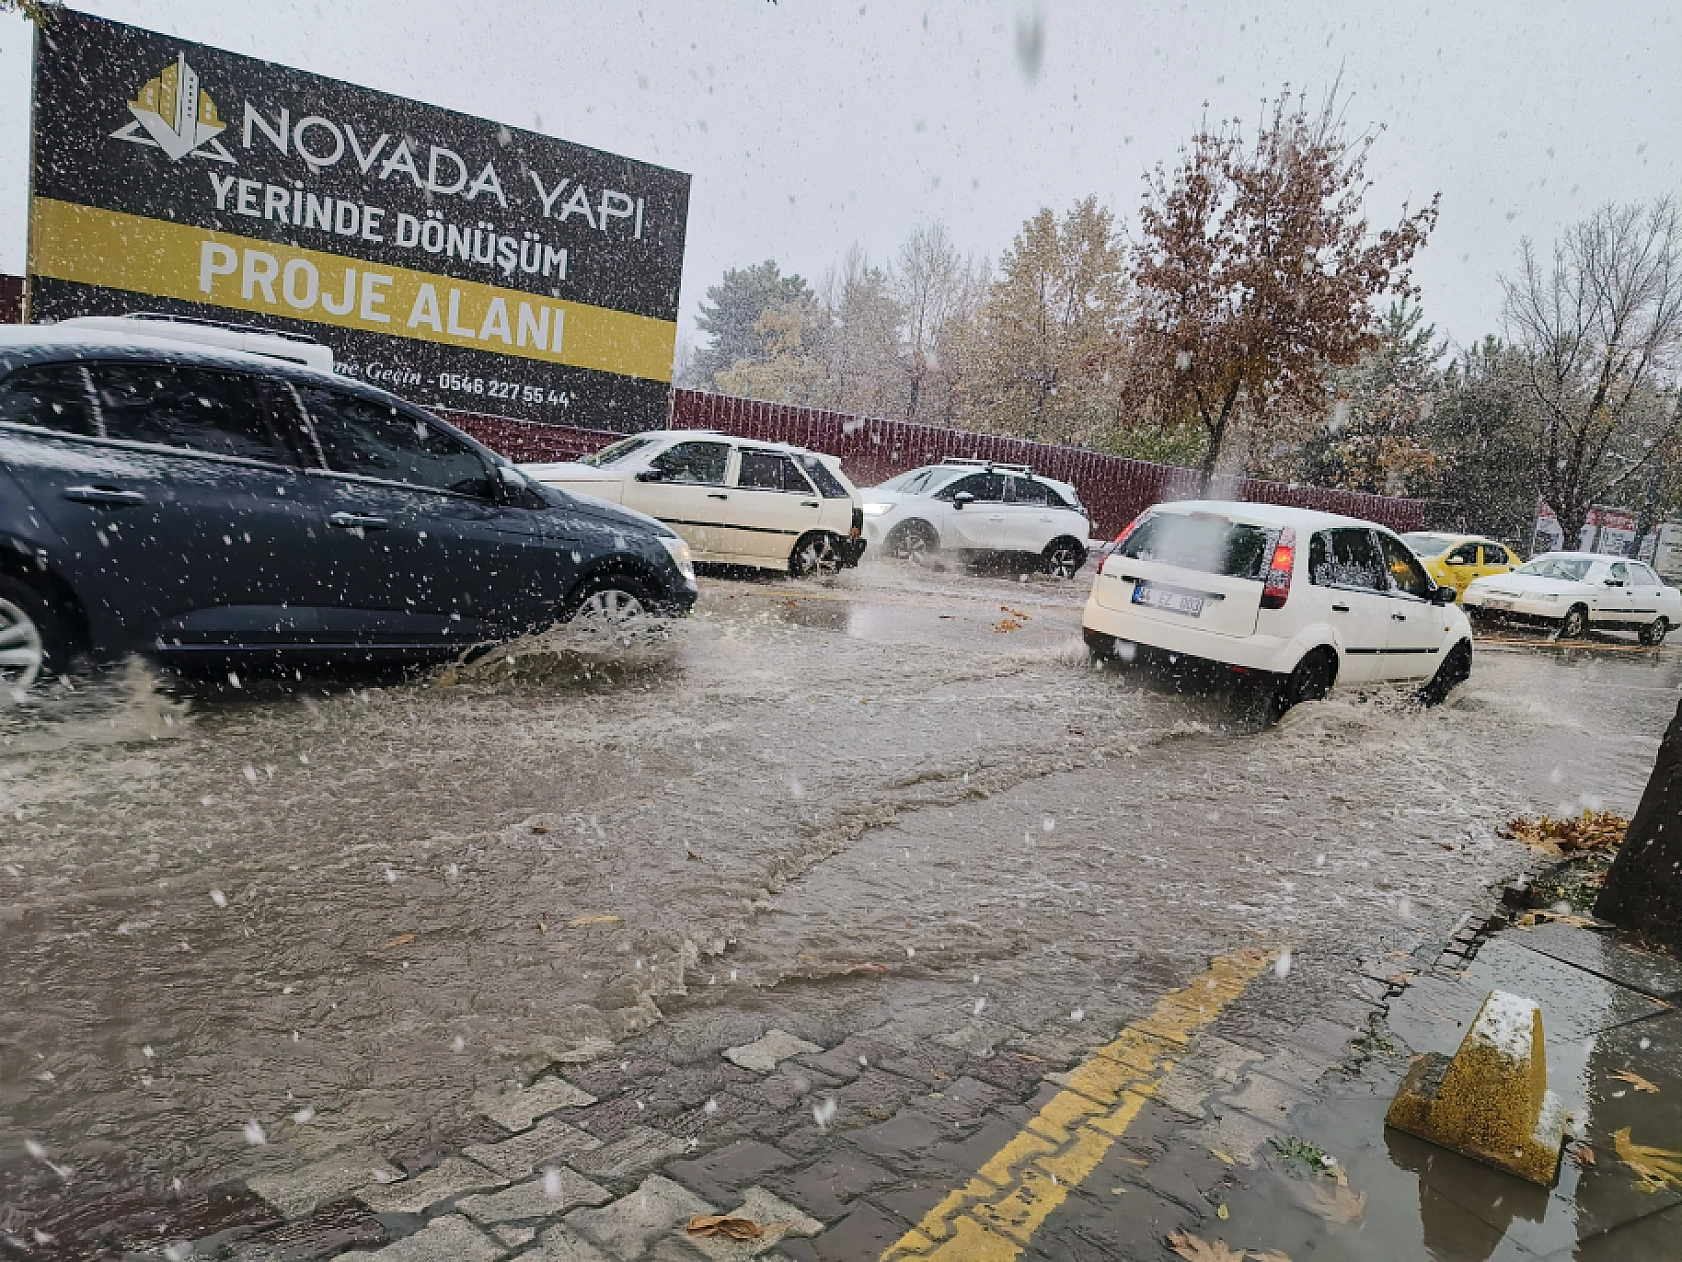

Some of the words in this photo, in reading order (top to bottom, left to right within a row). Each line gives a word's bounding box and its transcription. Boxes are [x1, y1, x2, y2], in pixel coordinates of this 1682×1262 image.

[243, 101, 507, 207] NOVADA
[529, 170, 643, 239] YAPI
[210, 172, 385, 242] YERİNDE
[396, 207, 568, 280] DÖNÜŞÜM
[199, 242, 394, 324] PROJE
[406, 284, 565, 354] ALANI
[439, 372, 484, 395] 0546
[488, 380, 519, 400] 227
[524, 385, 543, 403] 55
[547, 390, 569, 408] 44
